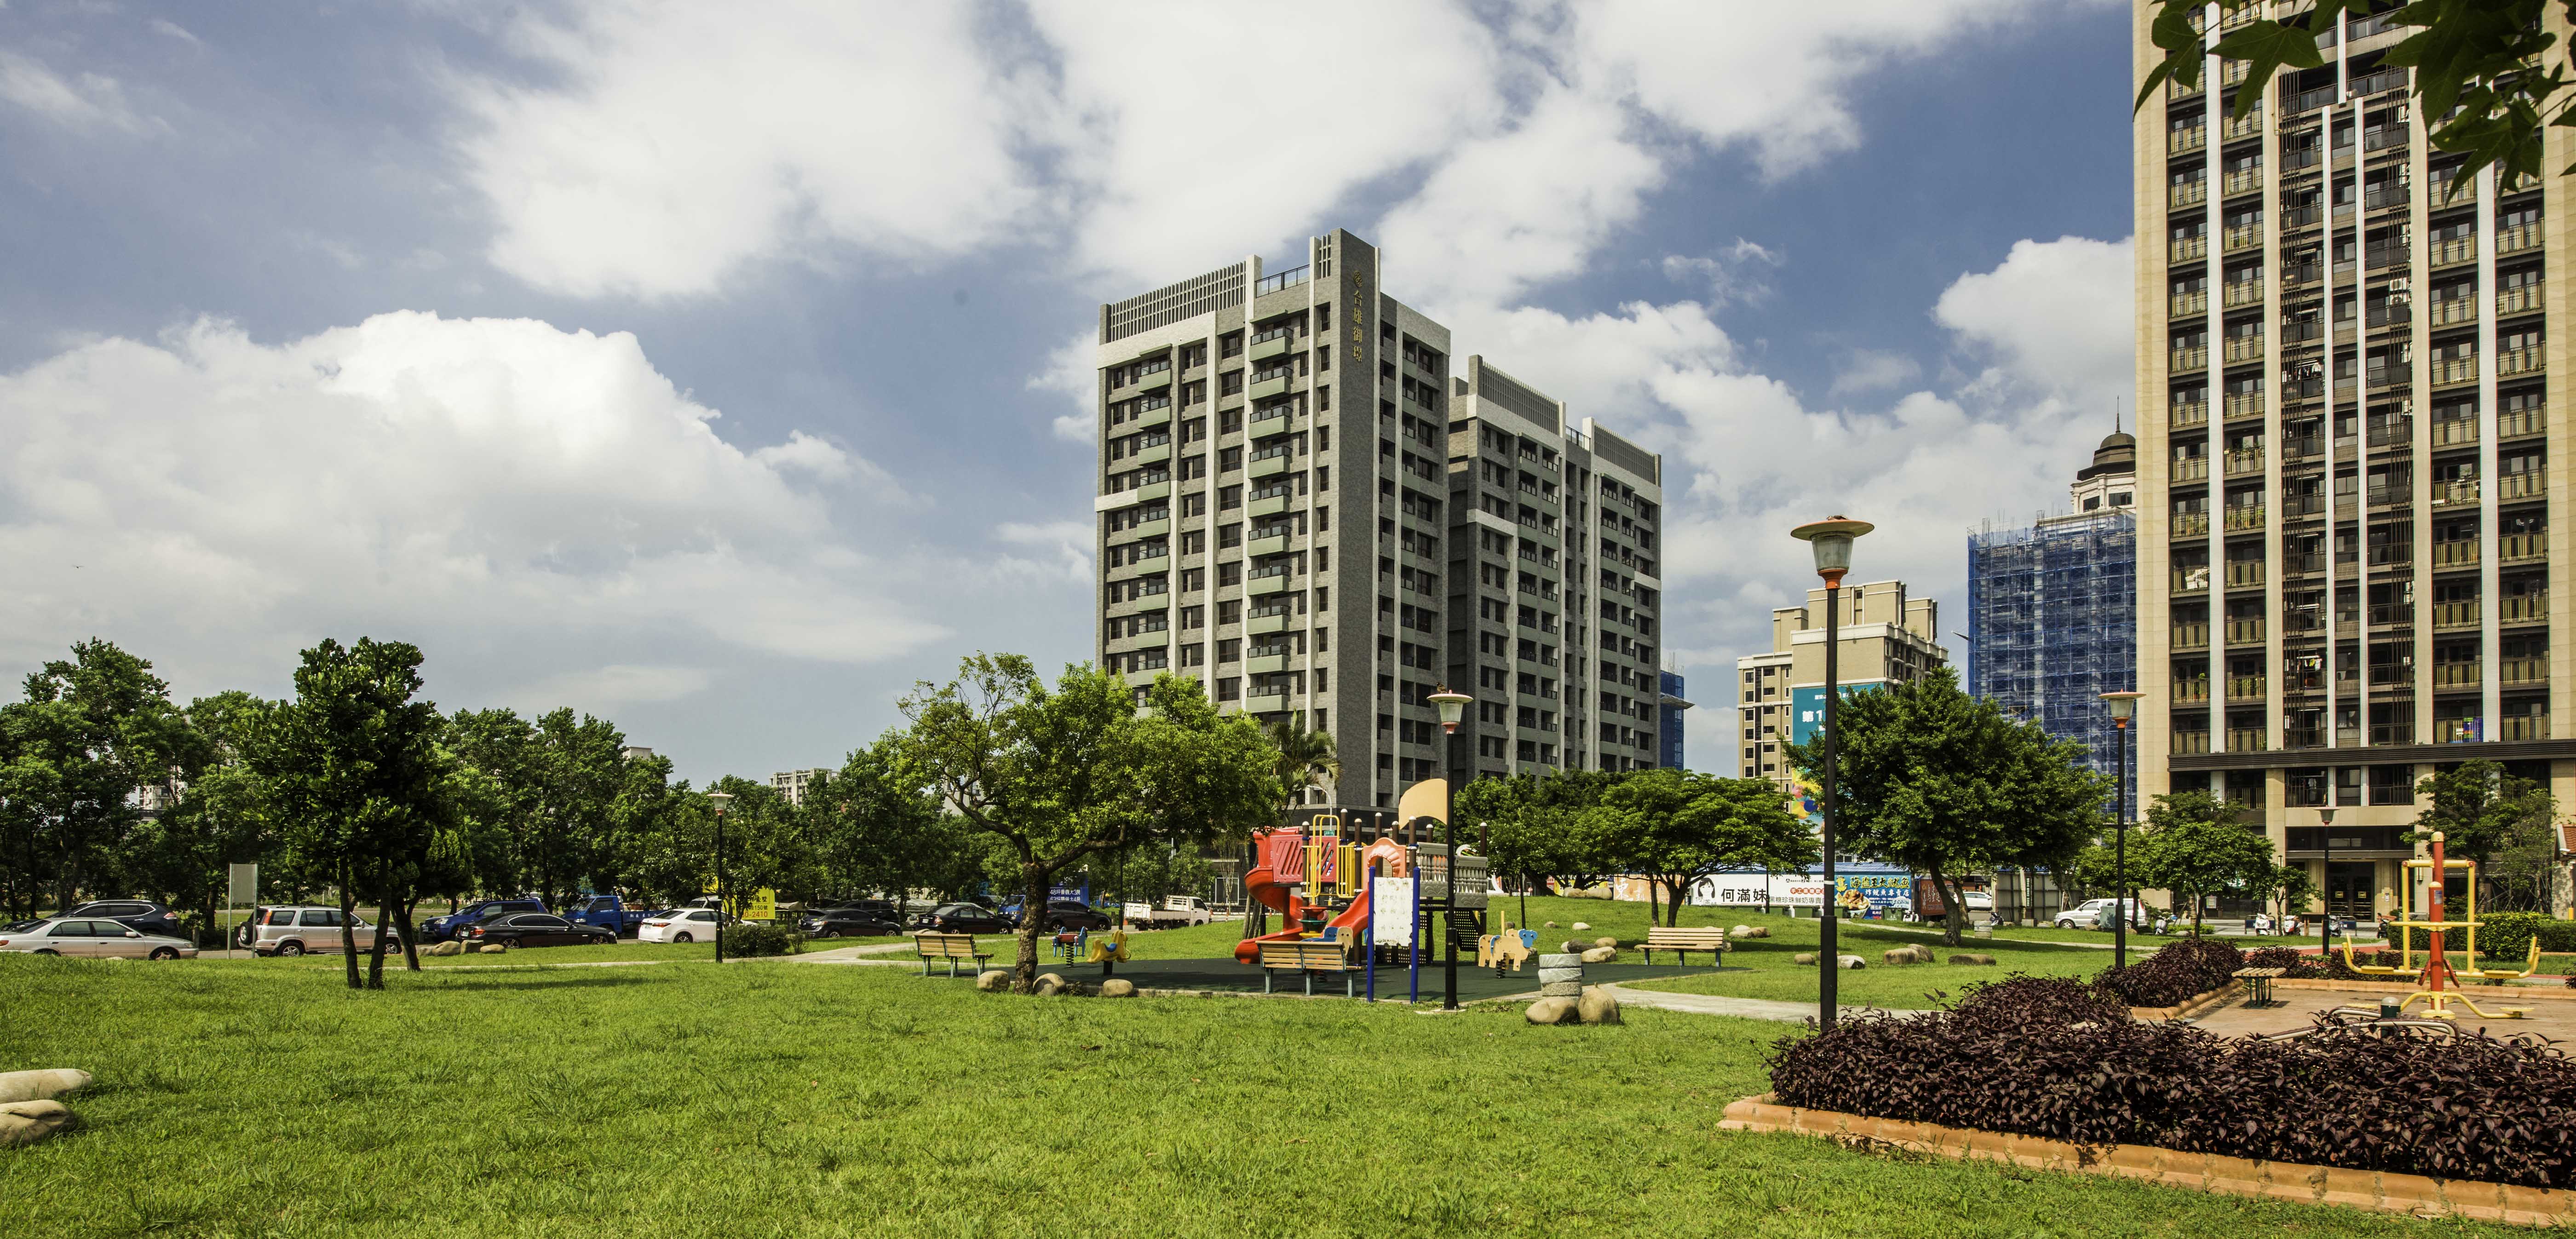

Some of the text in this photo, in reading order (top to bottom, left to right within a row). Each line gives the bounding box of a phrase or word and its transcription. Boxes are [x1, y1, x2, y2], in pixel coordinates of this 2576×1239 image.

[1850, 876, 1910, 889] 海盜王大魷魚
[1721, 888, 1766, 903] 何滿妹
